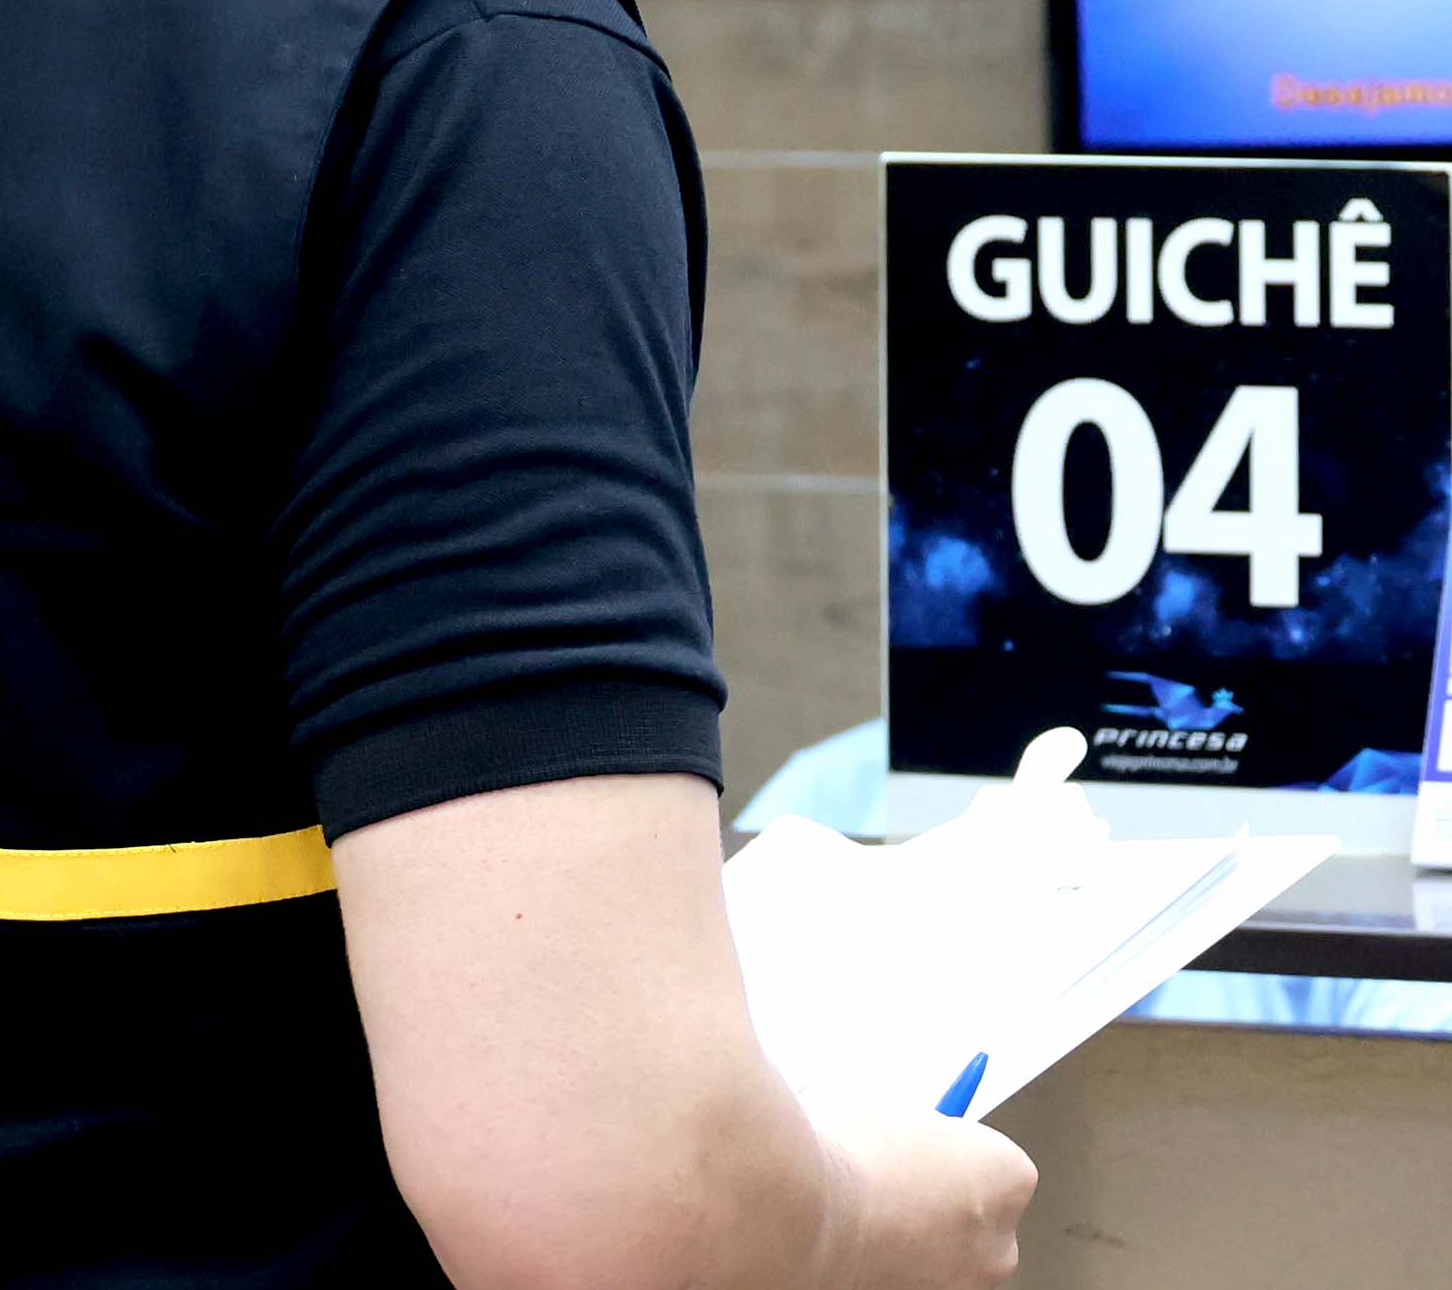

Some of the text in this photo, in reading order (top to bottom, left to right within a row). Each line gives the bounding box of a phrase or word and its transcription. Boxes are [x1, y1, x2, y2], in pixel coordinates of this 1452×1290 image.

[946, 197, 1395, 329] GUICHÊ
[1011, 377, 1324, 608] 04
[1093, 727, 1249, 752] princesa
